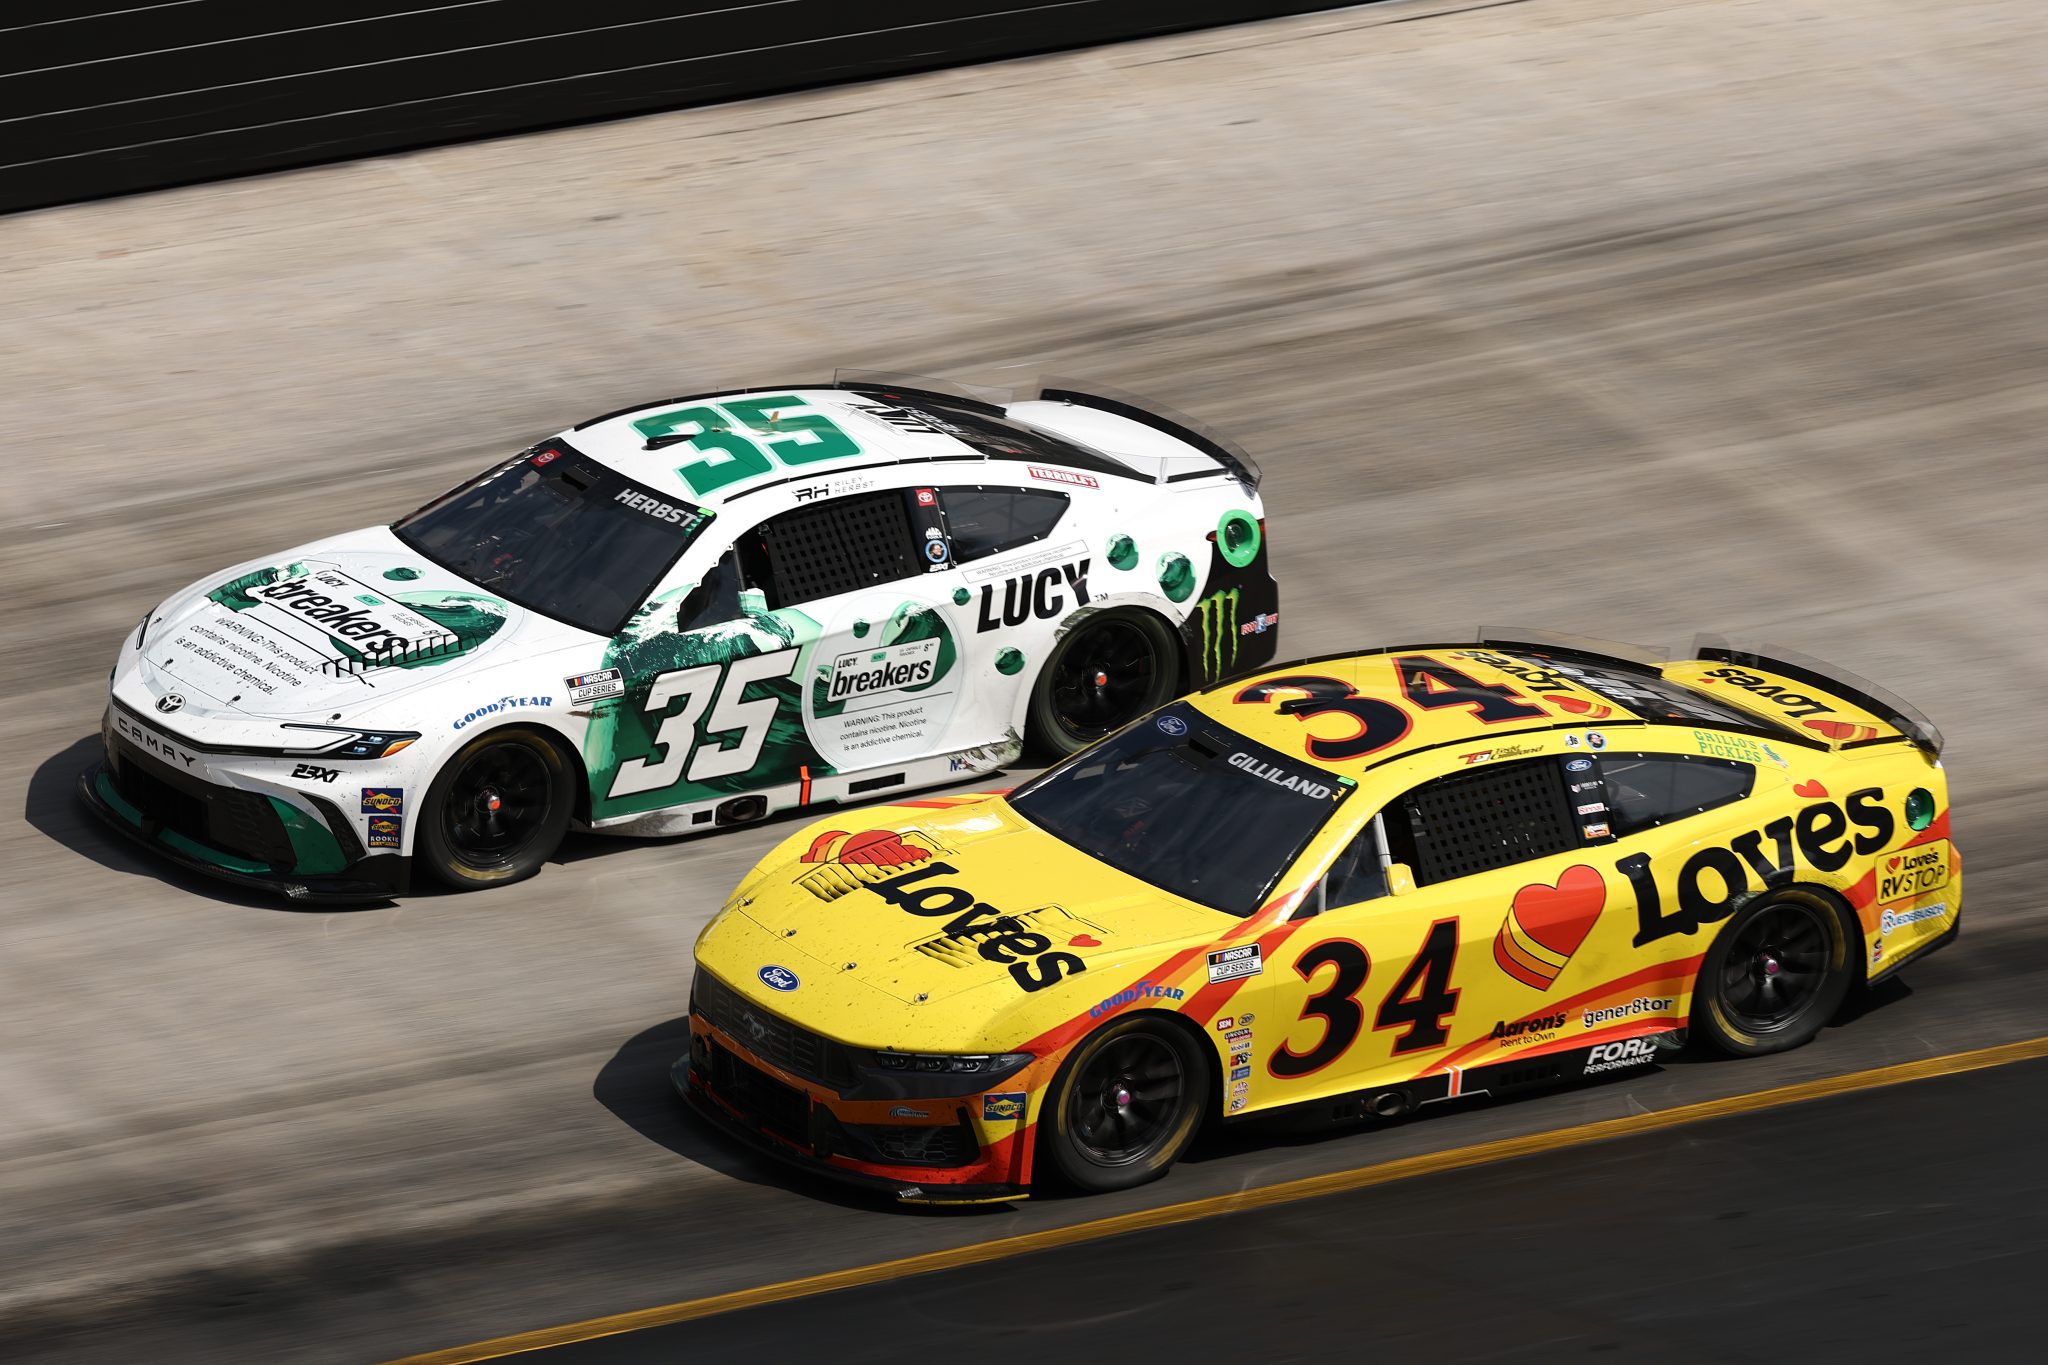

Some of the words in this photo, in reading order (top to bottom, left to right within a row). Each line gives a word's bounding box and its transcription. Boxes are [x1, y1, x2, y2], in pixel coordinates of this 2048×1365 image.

[629, 394, 864, 499] 35
[835, 476, 863, 487] RILEY
[835, 481, 875, 494] HERBST
[1028, 467, 1097, 487] TERRIBLE'S
[614, 488, 697, 527] HERBST
[977, 558, 1091, 633] LUCY
[258, 579, 410, 653] breakers
[174, 636, 184, 645] is
[182, 639, 196, 651] an
[194, 645, 235, 671] addictive
[190, 624, 229, 646] contains
[262, 661, 302, 687] Nicotine
[215, 617, 264, 646] WARNING:
[279, 651, 318, 675] product
[577, 687, 592, 698] CUP
[592, 683, 617, 695] SERIES
[583, 671, 612, 684] NASCAR
[832, 660, 931, 697] breakers
[453, 695, 553, 730] GOODYEAR
[608, 647, 799, 798] 35
[881, 711, 898, 720] This
[898, 706, 923, 719] product
[1233, 655, 1552, 762] 34
[118, 717, 196, 767] CAMRY
[840, 728, 868, 740] contains
[899, 718, 927, 729] Nicotine
[860, 736, 891, 748] addictive
[1694, 730, 1757, 749] GRILLO'S
[1698, 741, 1761, 762] PICKLES
[1227, 752, 1331, 800] GILLILAND
[363, 797, 402, 806] SUNOCO
[1216, 965, 1230, 976] CUP
[1230, 961, 1254, 973] SERIES
[1224, 948, 1253, 961] NASCAR
[1089, 980, 1185, 1018] GOODYEAR
[1268, 915, 1462, 1078] 34
[1489, 1011, 1567, 1040] Aaron's
[1585, 997, 1673, 1028] gener8tor
[1500, 1036, 1521, 1048] Rent
[1523, 1034, 1532, 1044] to
[1534, 1031, 1555, 1043] Own
[1586, 1039, 1658, 1066] FORD
[1583, 1053, 1655, 1075] PERFORMANCE
[985, 1103, 1025, 1113] SUNOCO
